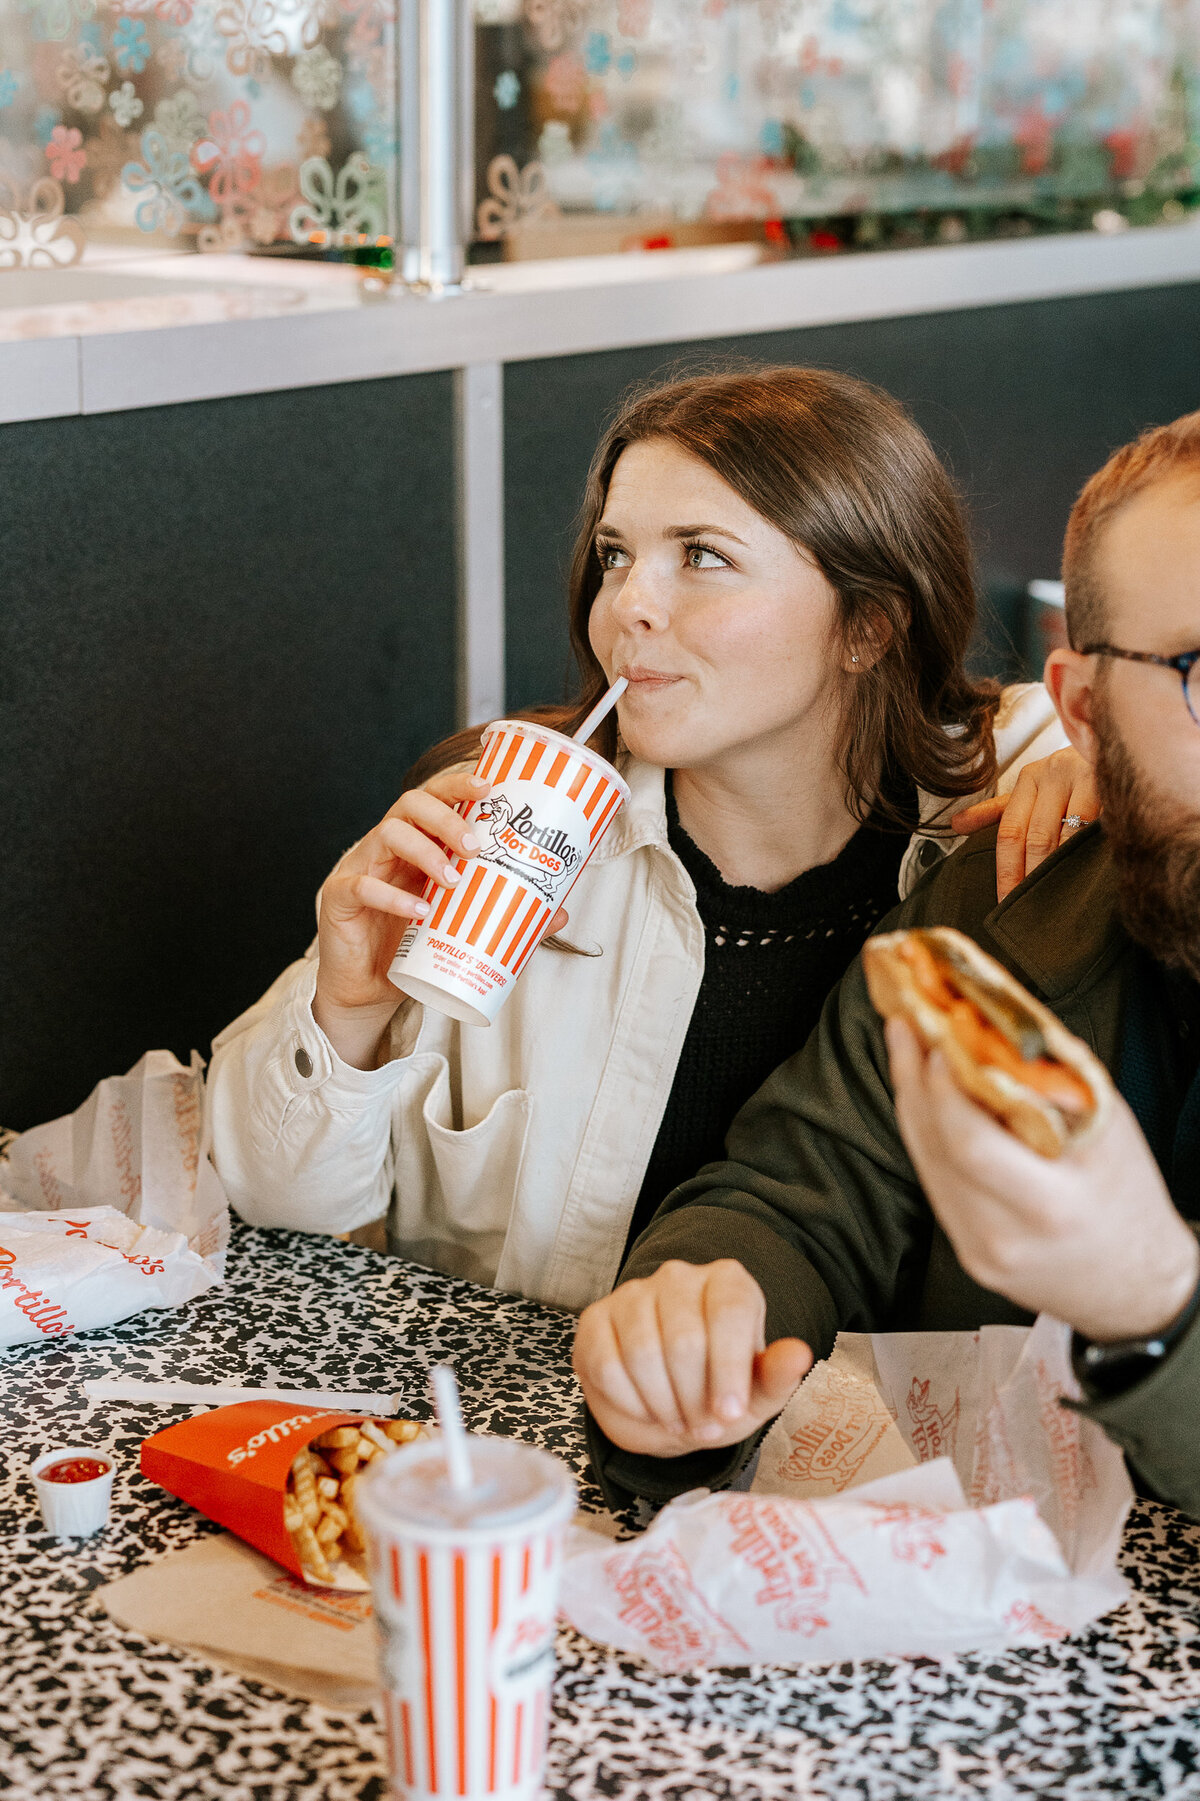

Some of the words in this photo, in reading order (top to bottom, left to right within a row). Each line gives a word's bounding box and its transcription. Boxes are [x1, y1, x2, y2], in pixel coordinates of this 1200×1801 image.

[499, 827, 528, 855] HOT
[528, 846, 562, 872] DOGS
[509, 803, 578, 867] Portillo's
[226, 1409, 345, 1469] ortillo's
